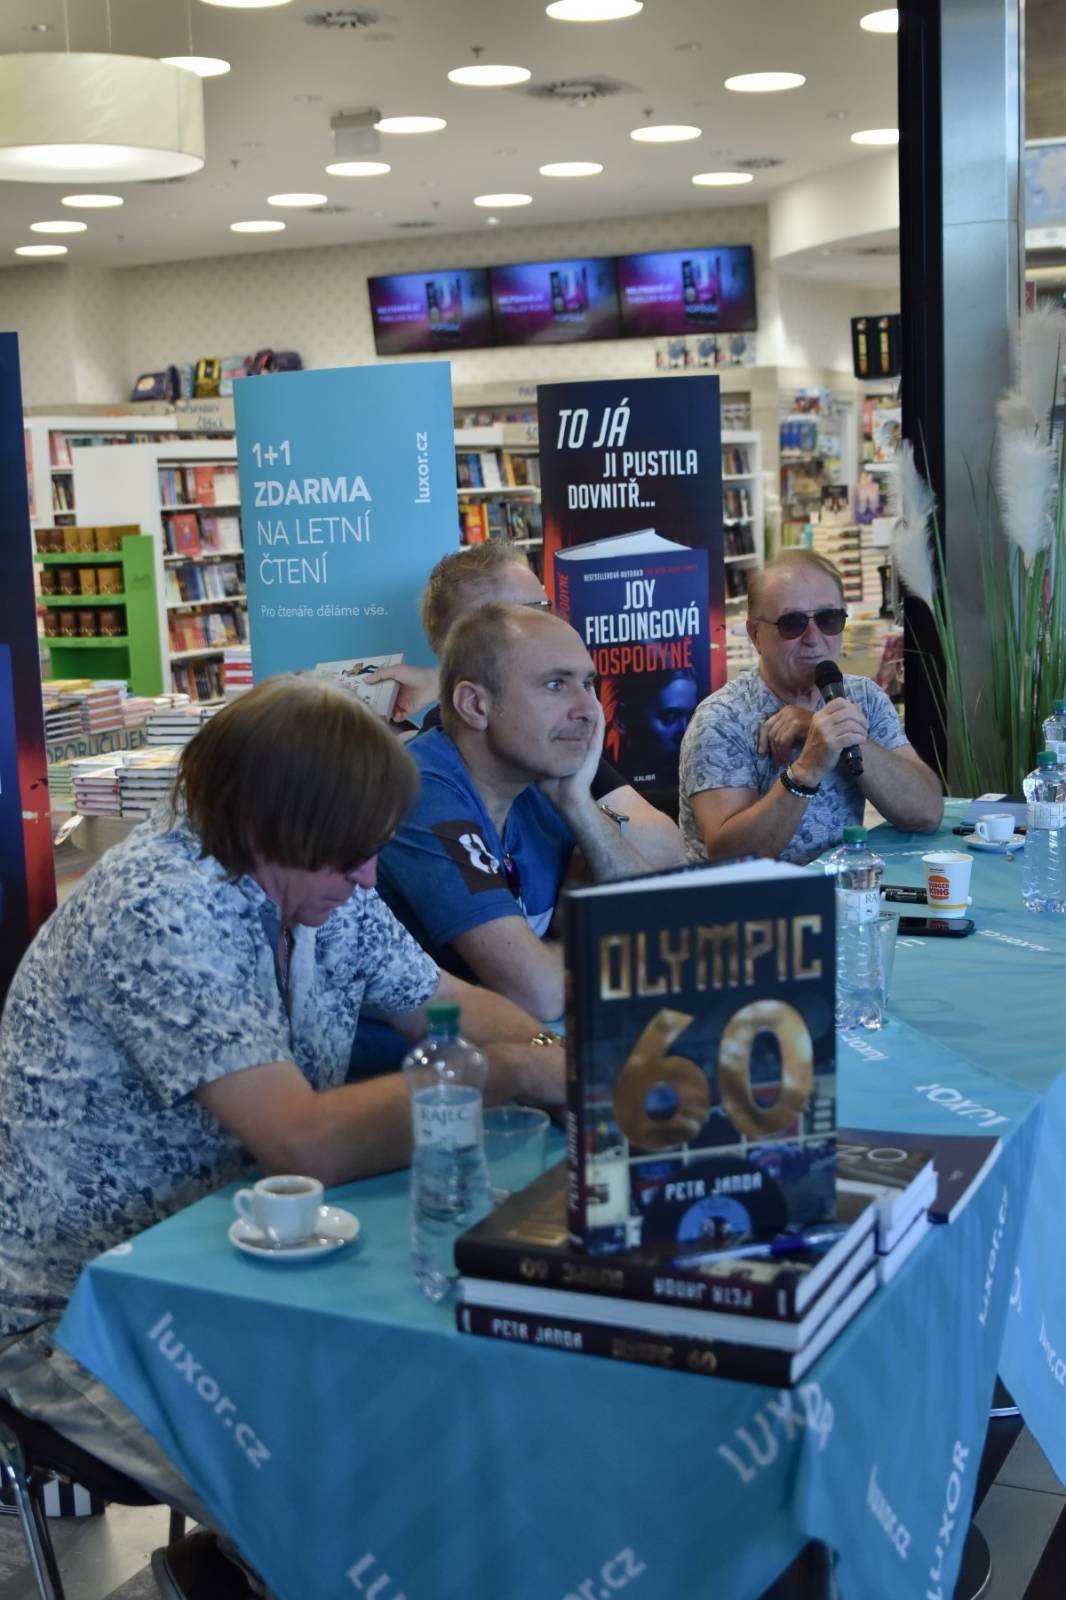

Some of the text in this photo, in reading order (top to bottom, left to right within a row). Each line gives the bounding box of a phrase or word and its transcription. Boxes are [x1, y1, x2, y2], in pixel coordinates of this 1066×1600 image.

[557, 397, 631, 449] TO JÁ
[252, 440, 291, 467] 1+1
[414, 431, 431, 503] luxor.cz
[603, 449, 698, 478] JI PUSTILA
[254, 476, 372, 507] ZDARMA
[568, 477, 656, 509] DOVNITŘ...
[257, 510, 371, 545] NA LETNÍ
[260, 552, 328, 585] ČTENÍ
[261, 604, 275, 616] Pro
[278, 604, 313, 617] čtenáře
[316, 604, 360, 616] děláme
[623, 579, 656, 610] JOY
[585, 601, 700, 645] FIELDINGOVÁ
[929, 888, 950, 896] KING
[600, 914, 823, 1000] OLYMPIC
[612, 999, 815, 1152] 60
[665, 1172, 762, 1201] PETR JANDA
[492, 1318, 529, 1340] PETR
[535, 1325, 584, 1349] JANDA
[147, 1312, 272, 1470] luxor.cz
